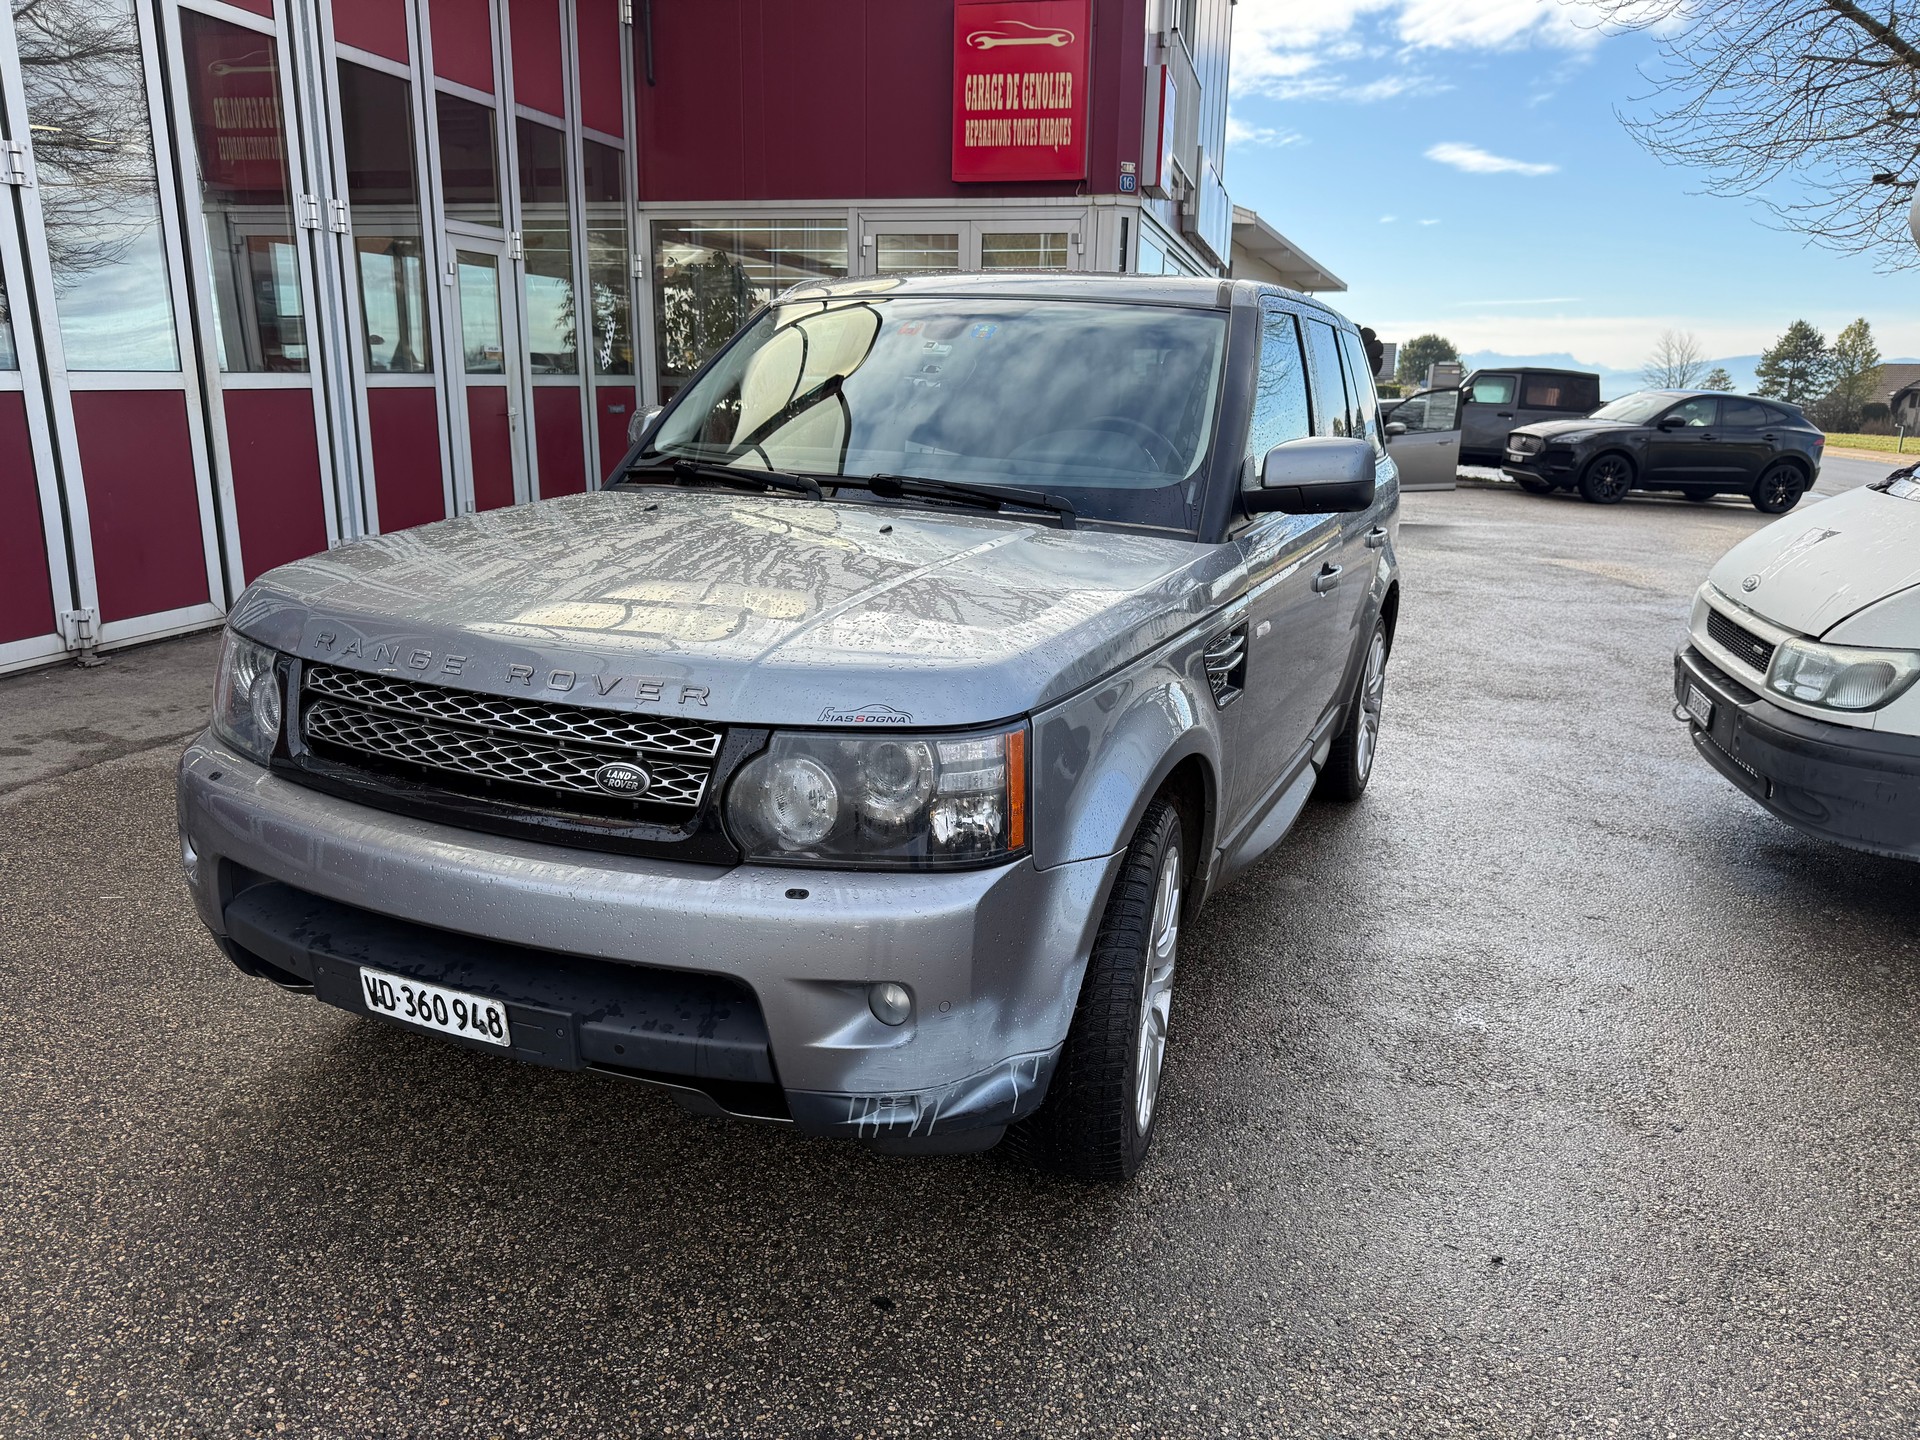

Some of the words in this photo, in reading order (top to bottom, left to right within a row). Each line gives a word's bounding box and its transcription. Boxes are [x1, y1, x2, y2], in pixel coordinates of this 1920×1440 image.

[965, 73, 1004, 111] GARAGE
[1005, 73, 1020, 110] DE
[1022, 72, 1073, 110] GENOLIER
[965, 118, 1011, 147] REPARATIONS
[1013, 118, 1038, 146] TOUTES
[1039, 118, 1072, 153] MARQUES
[1123, 176, 1134, 190] 16
[313, 631, 468, 676] RANGE
[505, 663, 711, 707] ROVER
[606, 769, 632, 780] LAND
[608, 779, 639, 791] ROVER
